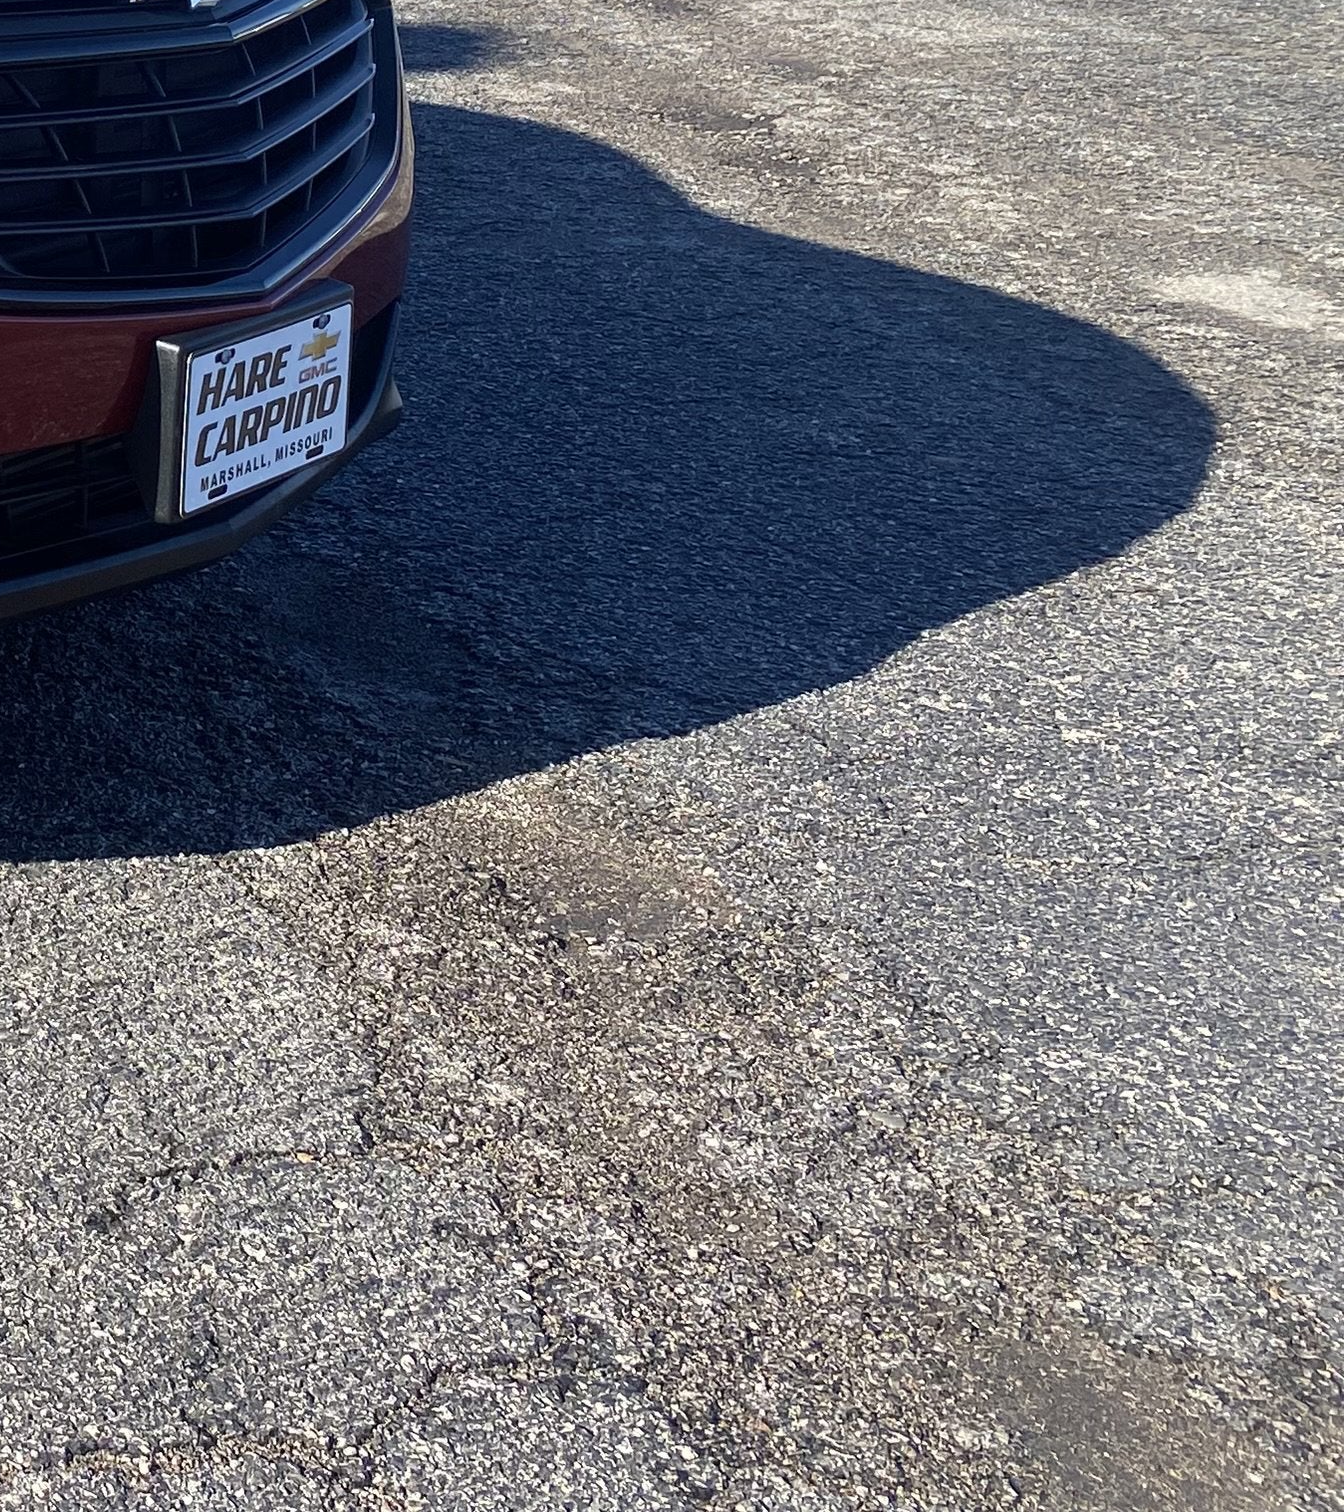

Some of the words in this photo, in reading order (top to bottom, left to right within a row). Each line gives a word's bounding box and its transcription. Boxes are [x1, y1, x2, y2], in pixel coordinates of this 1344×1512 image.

[196, 344, 292, 416] HARE
[298, 357, 337, 384] GMC
[194, 374, 342, 467] CARPINO
[200, 457, 272, 493] MARSHALL,
[274, 426, 333, 463] MISSOURI
